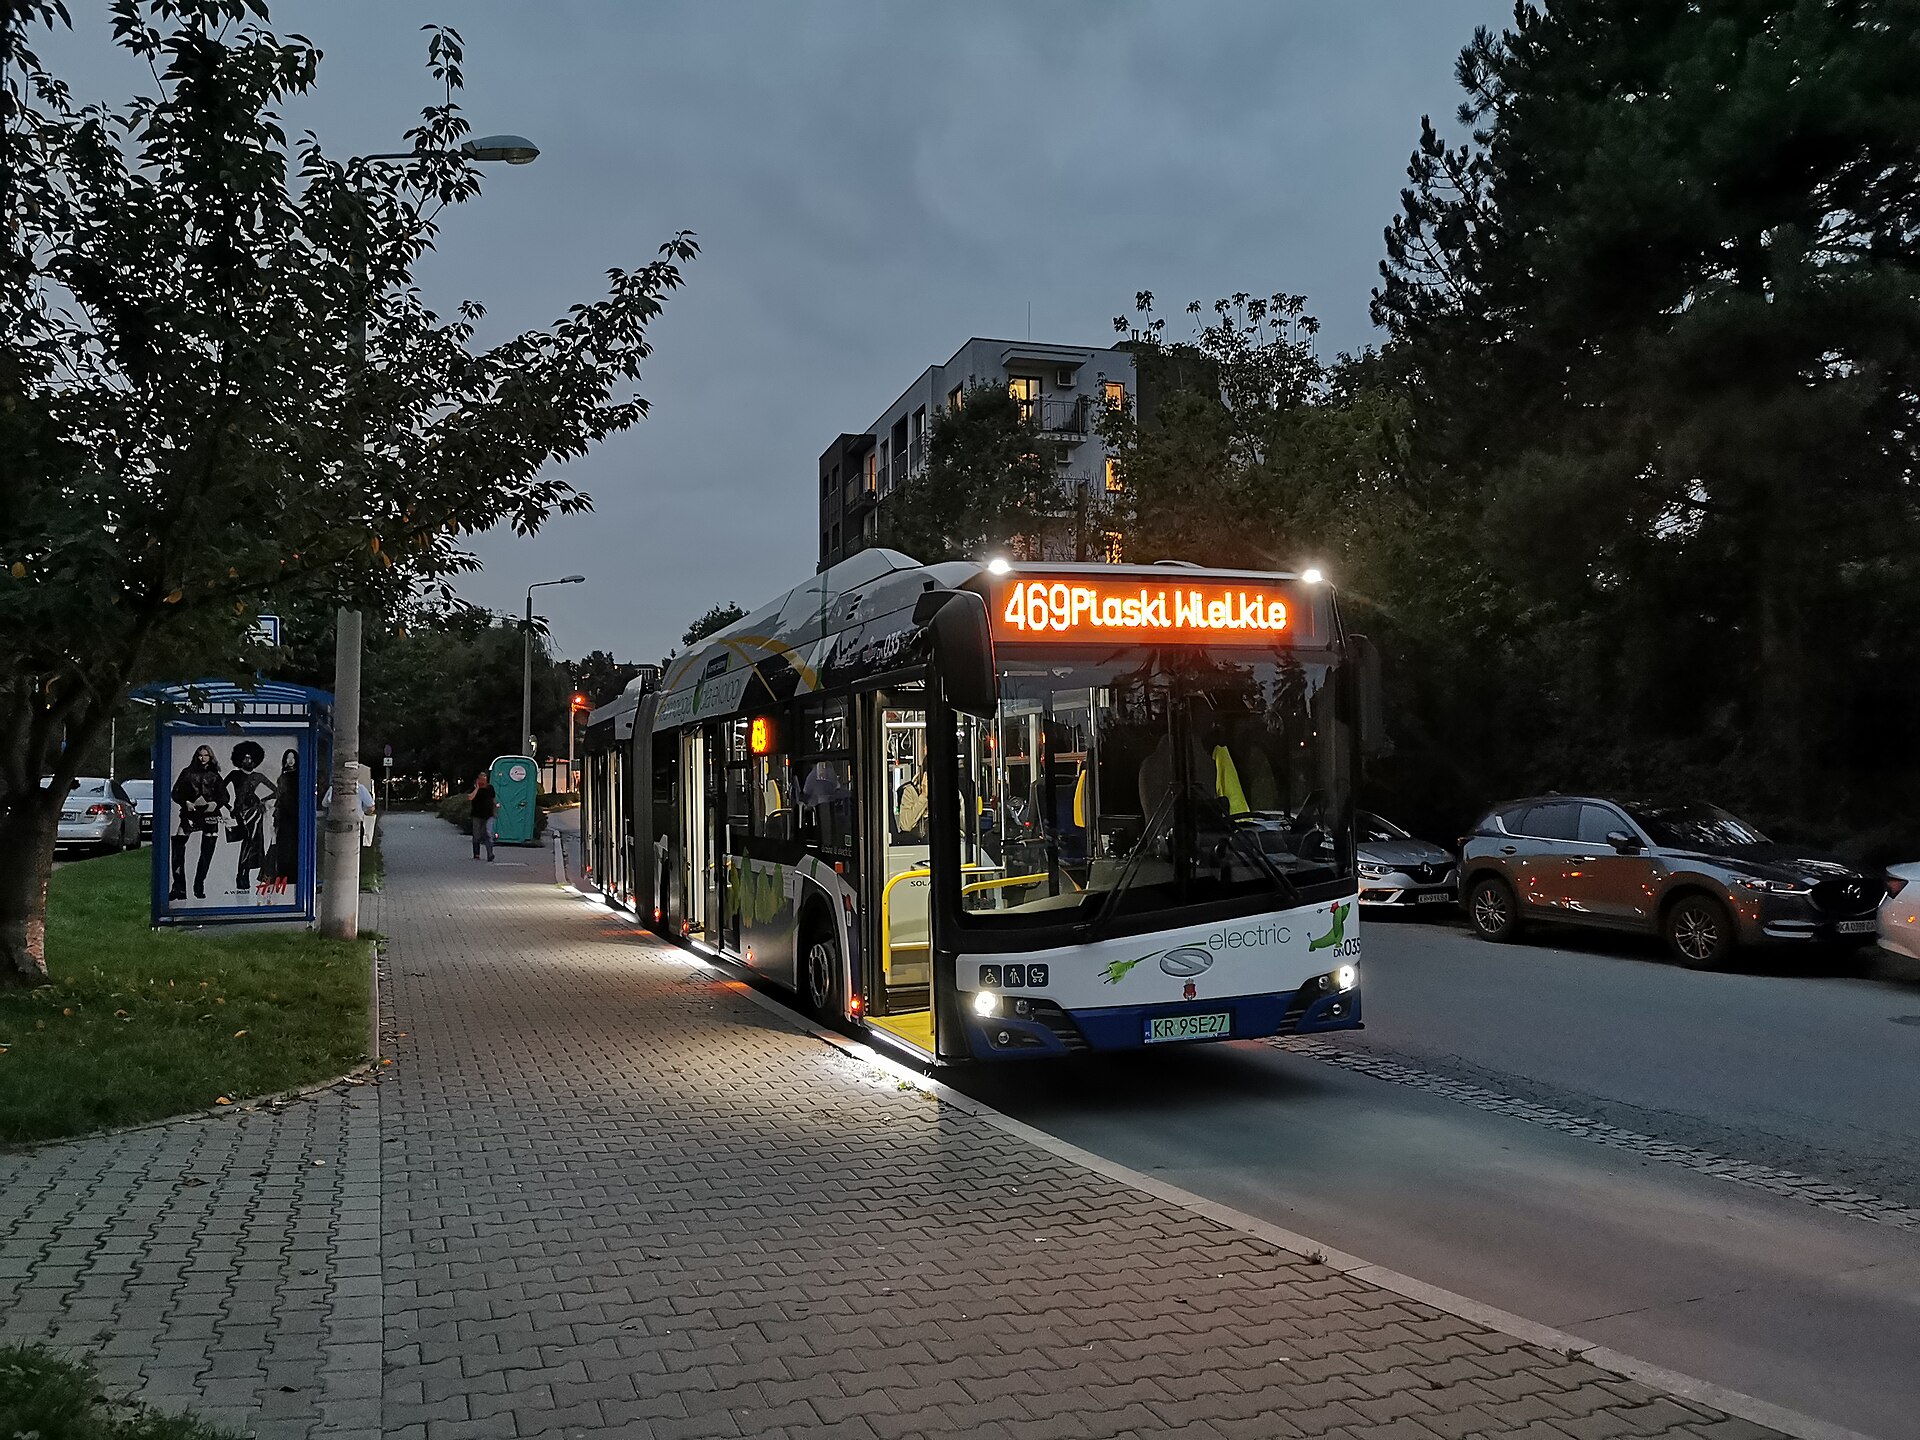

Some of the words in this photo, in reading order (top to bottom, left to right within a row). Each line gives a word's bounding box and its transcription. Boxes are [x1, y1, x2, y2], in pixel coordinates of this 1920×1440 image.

[1004, 582, 1071, 631] 469
[1072, 587, 1172, 627] Piaski
[1174, 590, 1287, 630] Wielkie
[1208, 923, 1291, 951] electric
[1153, 1019, 1175, 1039] KR
[1179, 1014, 1227, 1037] 9SE27
